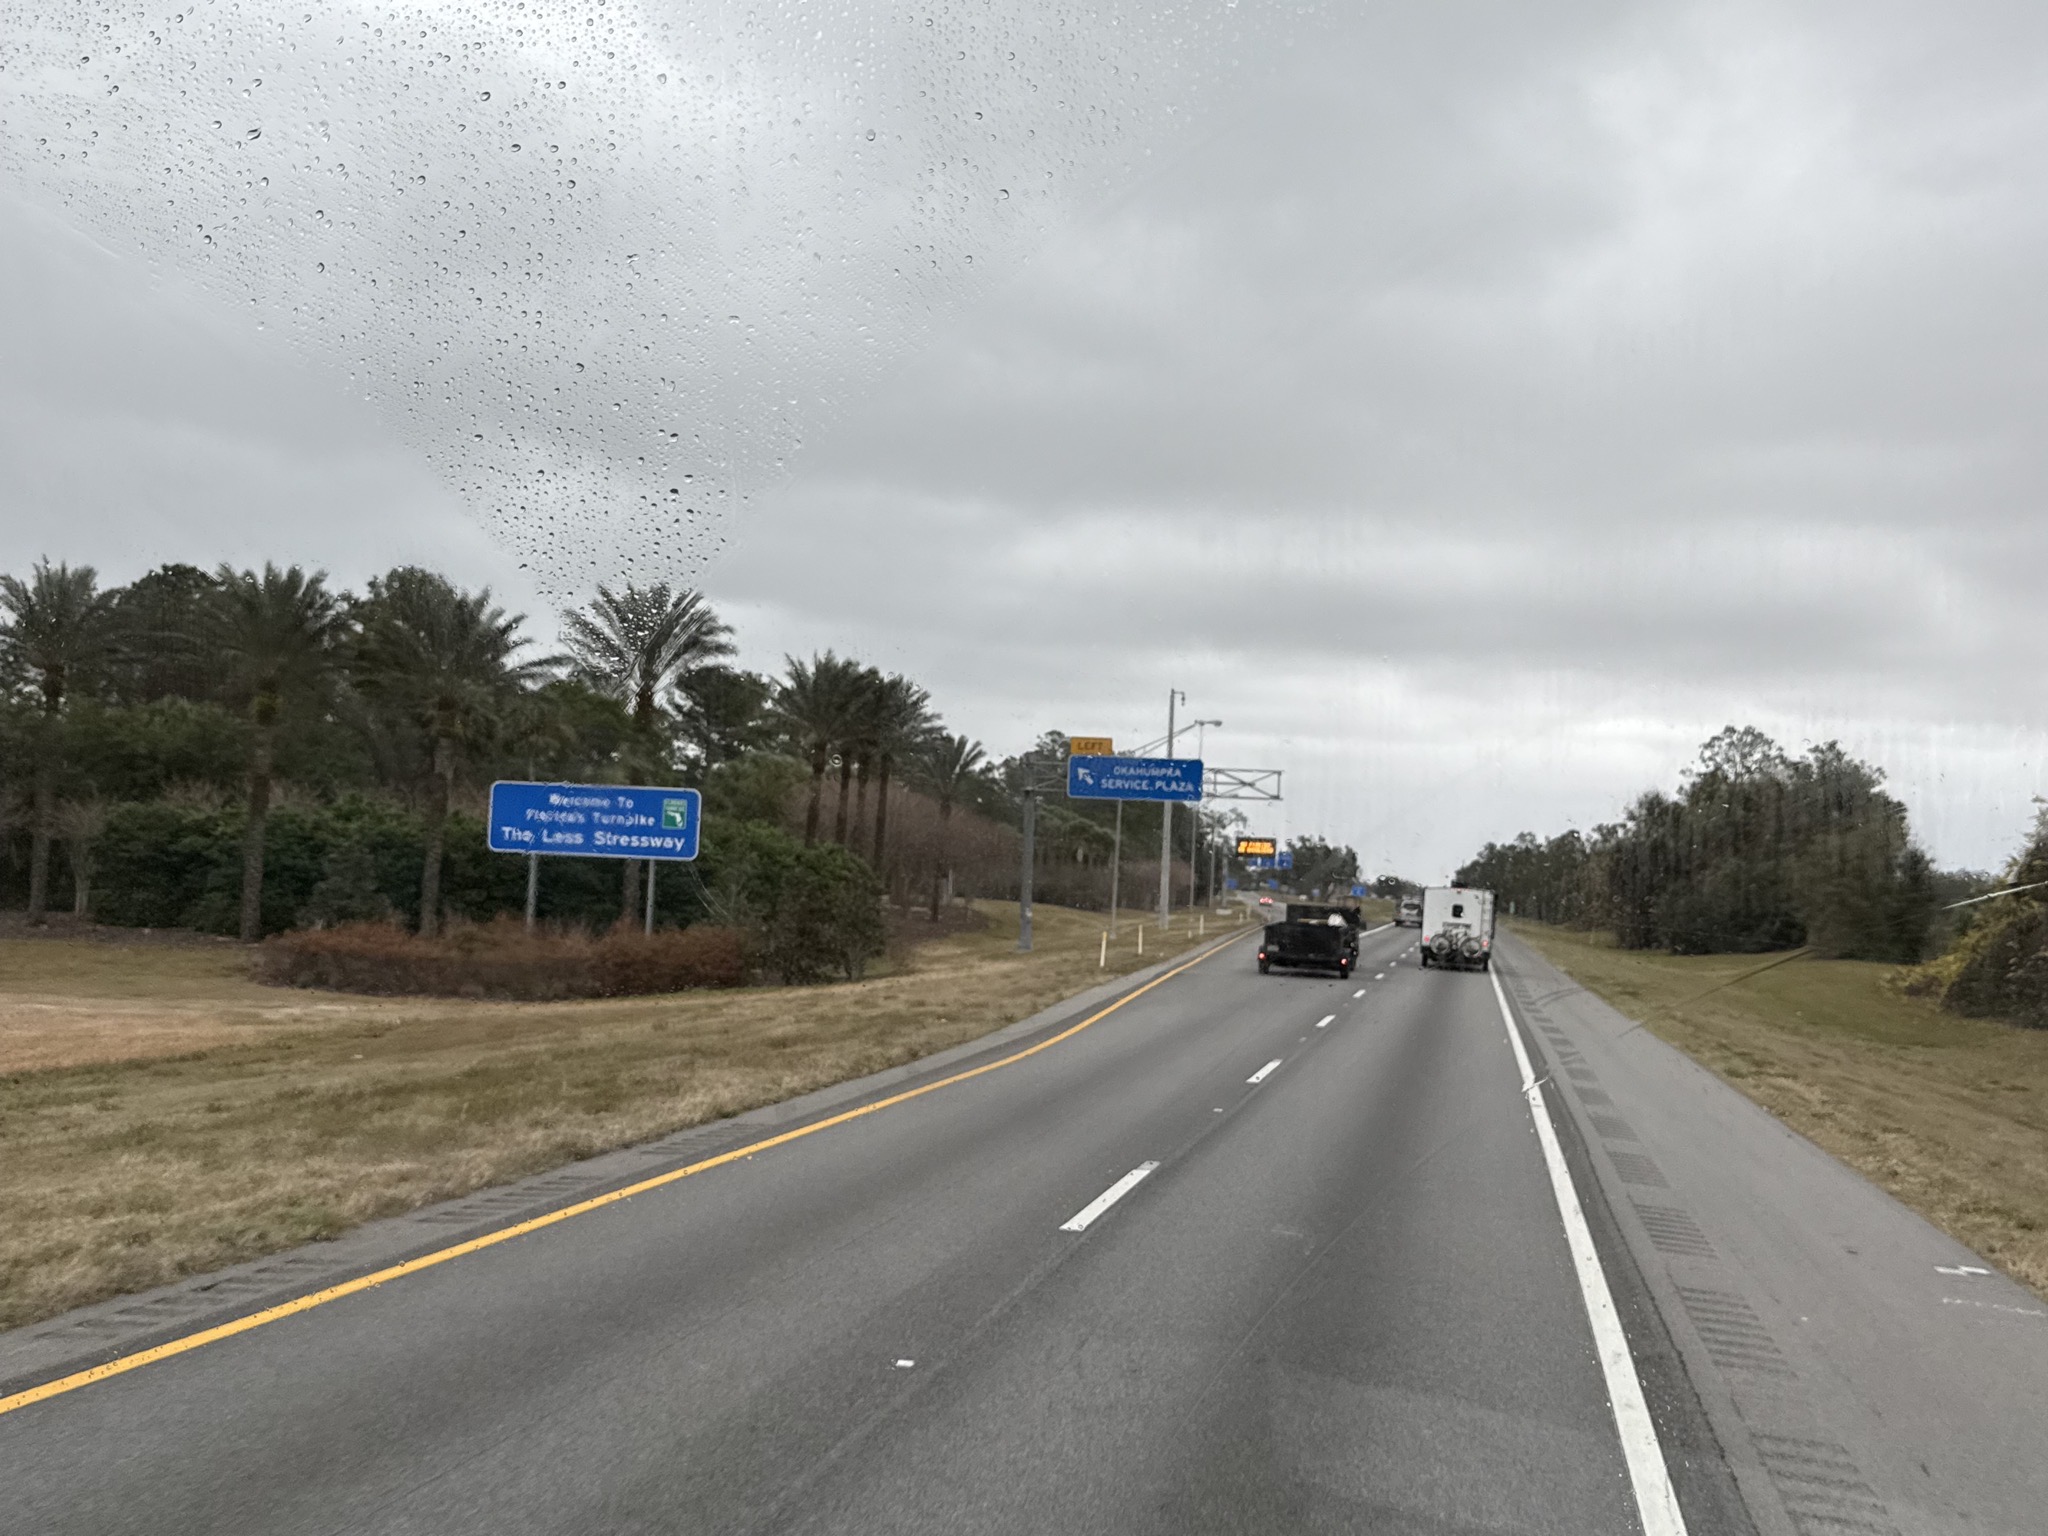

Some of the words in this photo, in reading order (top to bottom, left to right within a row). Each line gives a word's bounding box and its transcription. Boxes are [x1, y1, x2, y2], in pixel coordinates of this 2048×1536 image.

[1101, 778, 1149, 790] SERVICE
[1155, 780, 1194, 792] PLAZA
[617, 796, 634, 809] To
[592, 811, 656, 827] Turnpike
[501, 826, 533, 841] The
[541, 828, 585, 845] Less
[594, 831, 685, 852] Stressway
